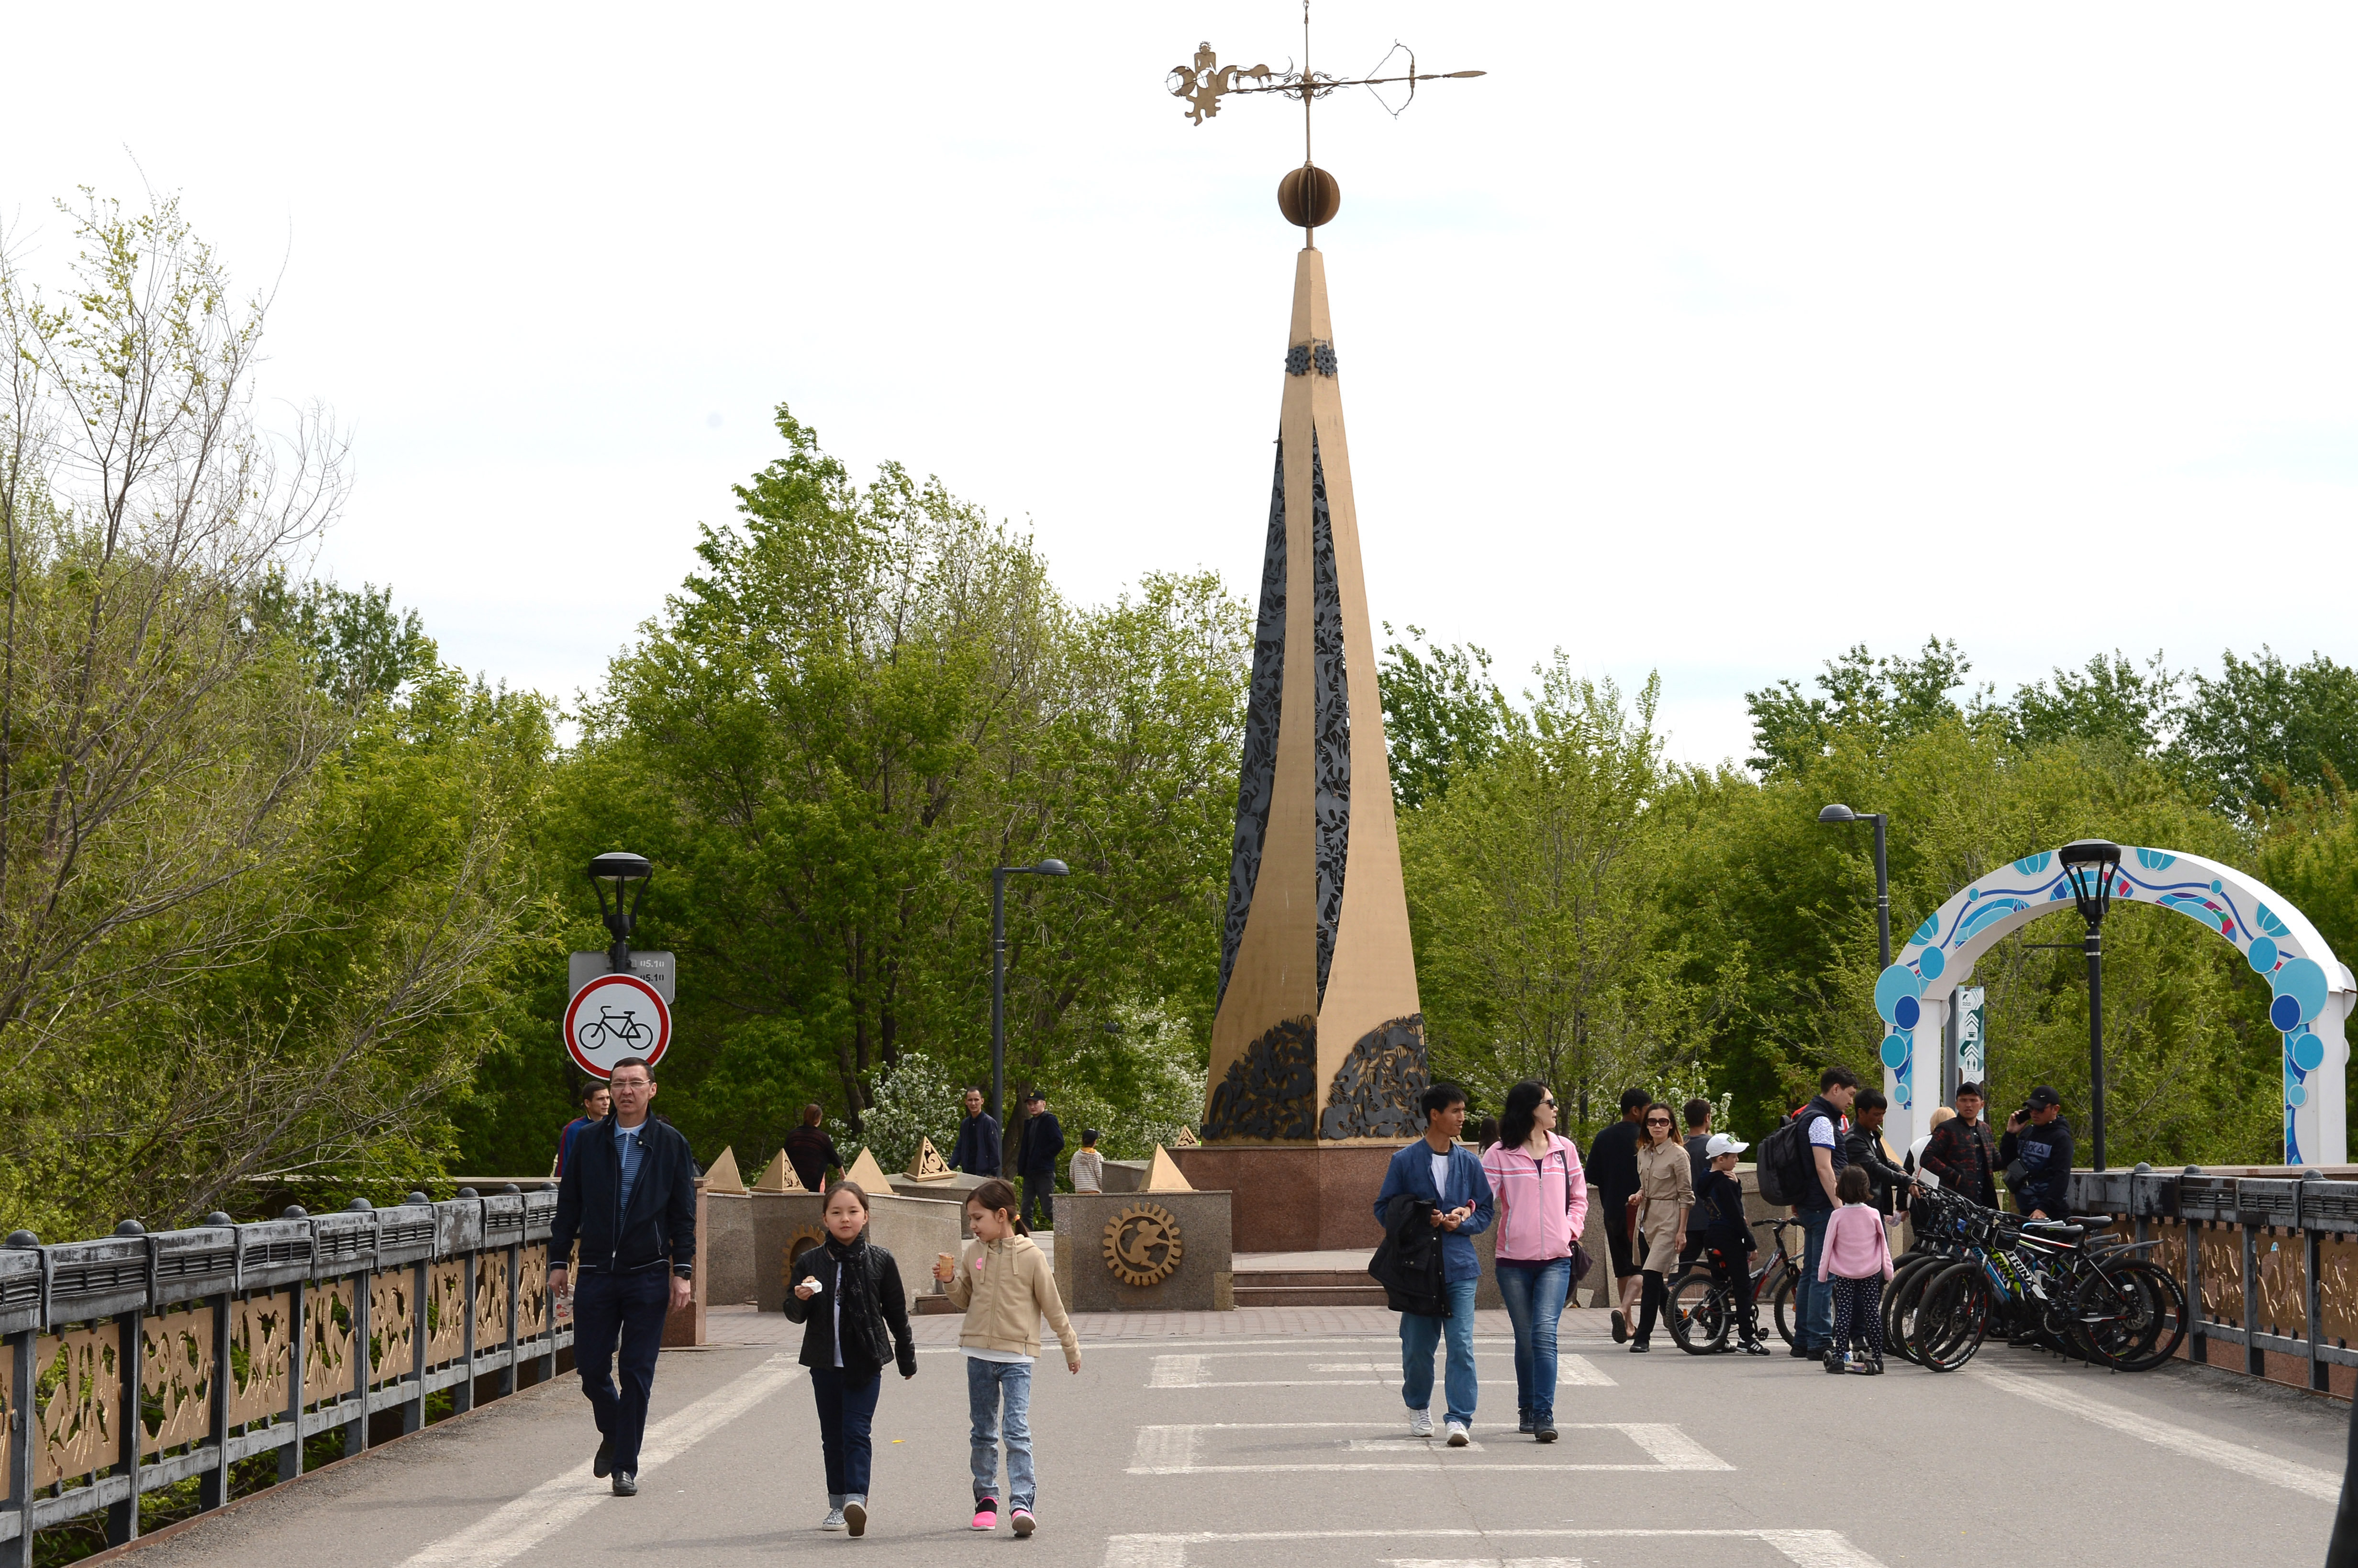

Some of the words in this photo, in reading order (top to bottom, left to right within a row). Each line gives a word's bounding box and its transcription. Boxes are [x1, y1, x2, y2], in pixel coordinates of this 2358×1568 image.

[1973, 1246, 1985, 1261] RIN
[1991, 1251, 2018, 1283] TRINX
[2008, 1252, 2036, 1288] TRINX
[2160, 1274, 2173, 1284] JACK
